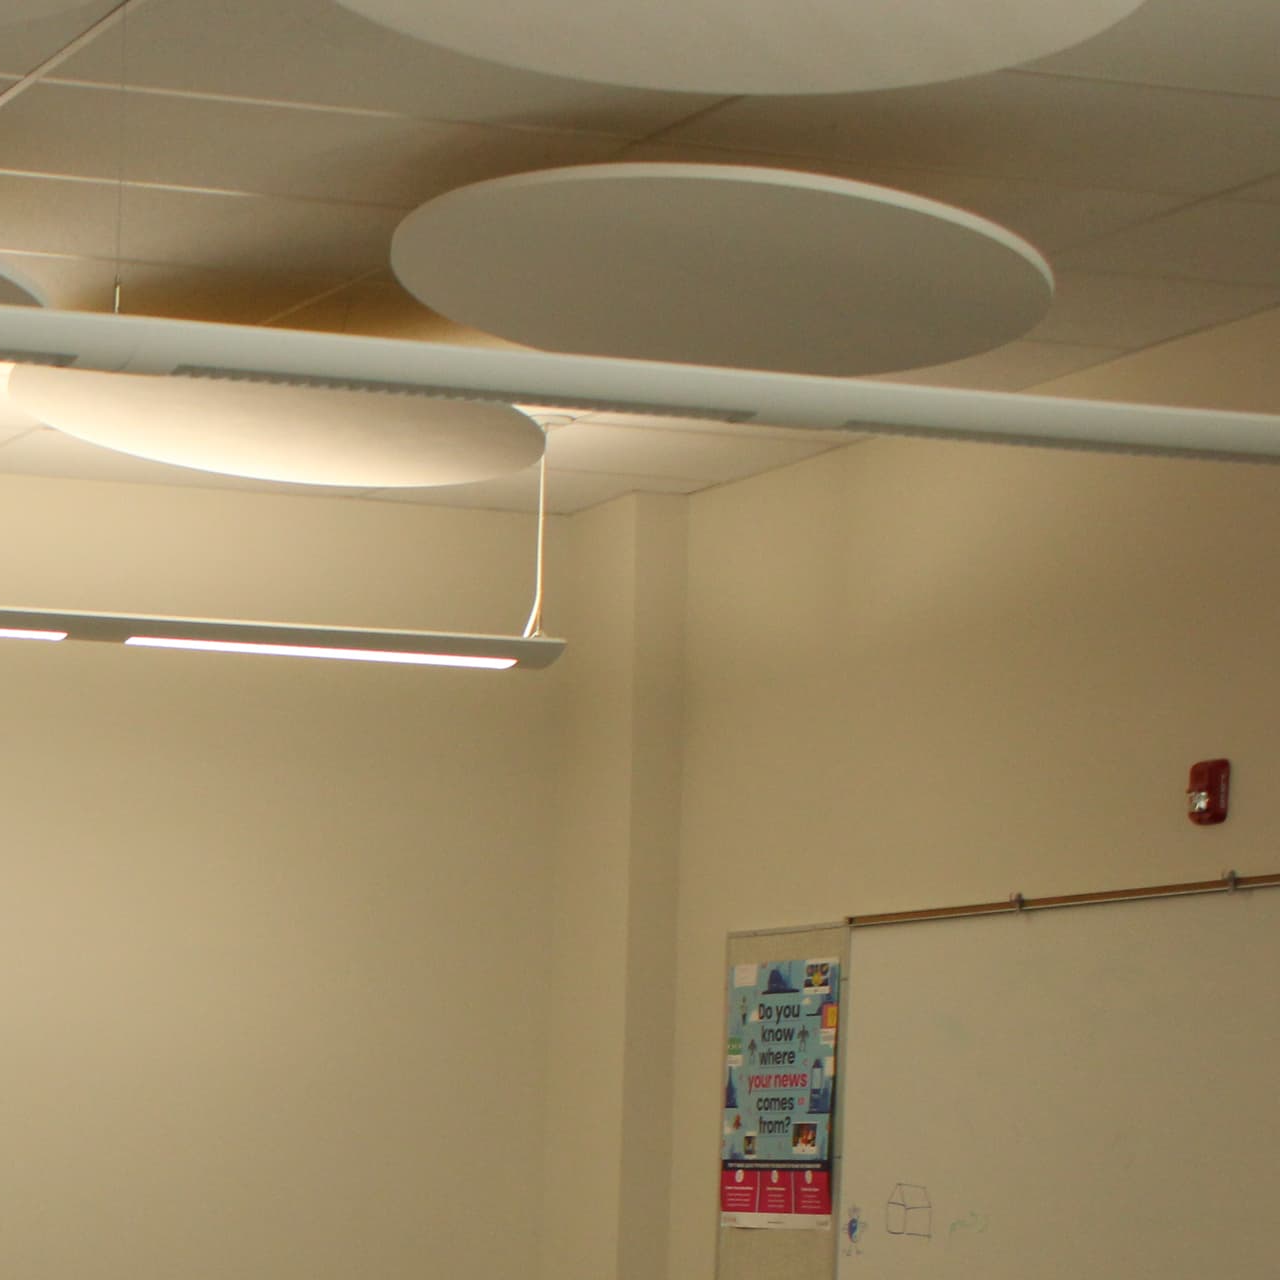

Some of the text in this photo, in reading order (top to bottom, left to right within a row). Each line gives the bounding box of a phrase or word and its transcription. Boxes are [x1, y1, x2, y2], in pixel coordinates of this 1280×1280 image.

[758, 1003, 801, 1025] Do you
[761, 1025, 795, 1042] know
[758, 1048, 796, 1066] where
[747, 1072, 809, 1096] your news
[756, 1096, 794, 1112] comes
[759, 1116, 792, 1134] from?
